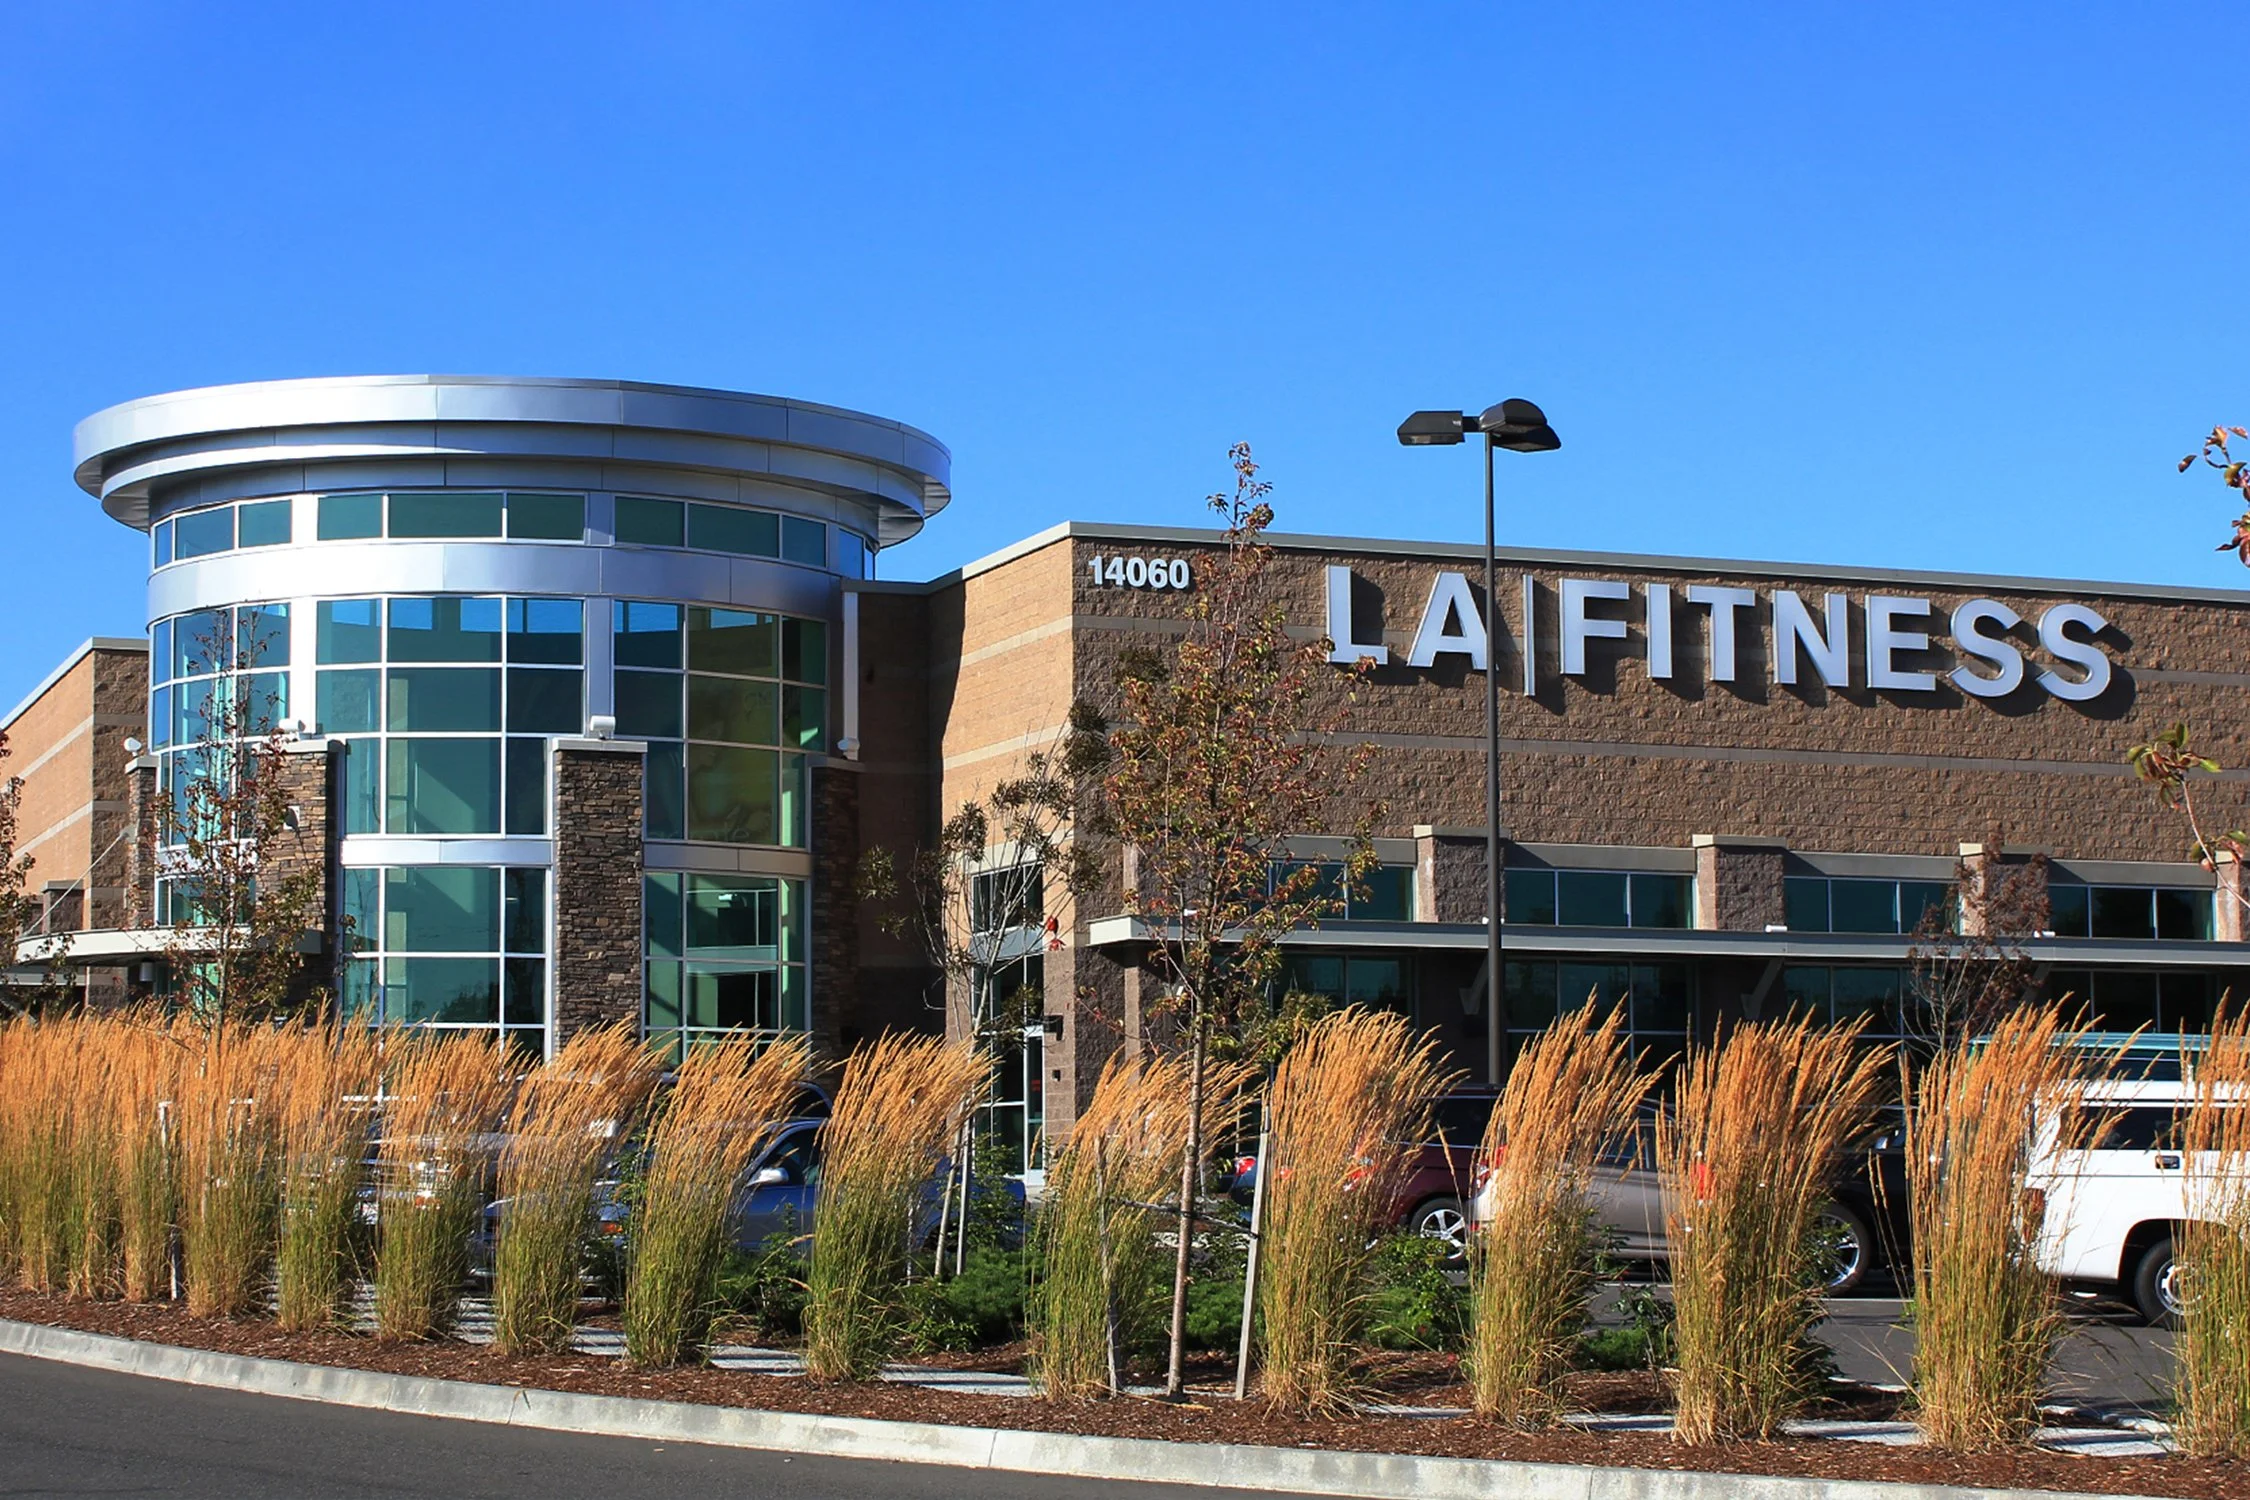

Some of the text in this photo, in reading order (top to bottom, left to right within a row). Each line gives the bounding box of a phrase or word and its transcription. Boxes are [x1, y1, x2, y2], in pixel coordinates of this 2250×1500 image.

[1088, 556, 1189, 589] 14060
[1325, 565, 2111, 701] LA FITNESS
